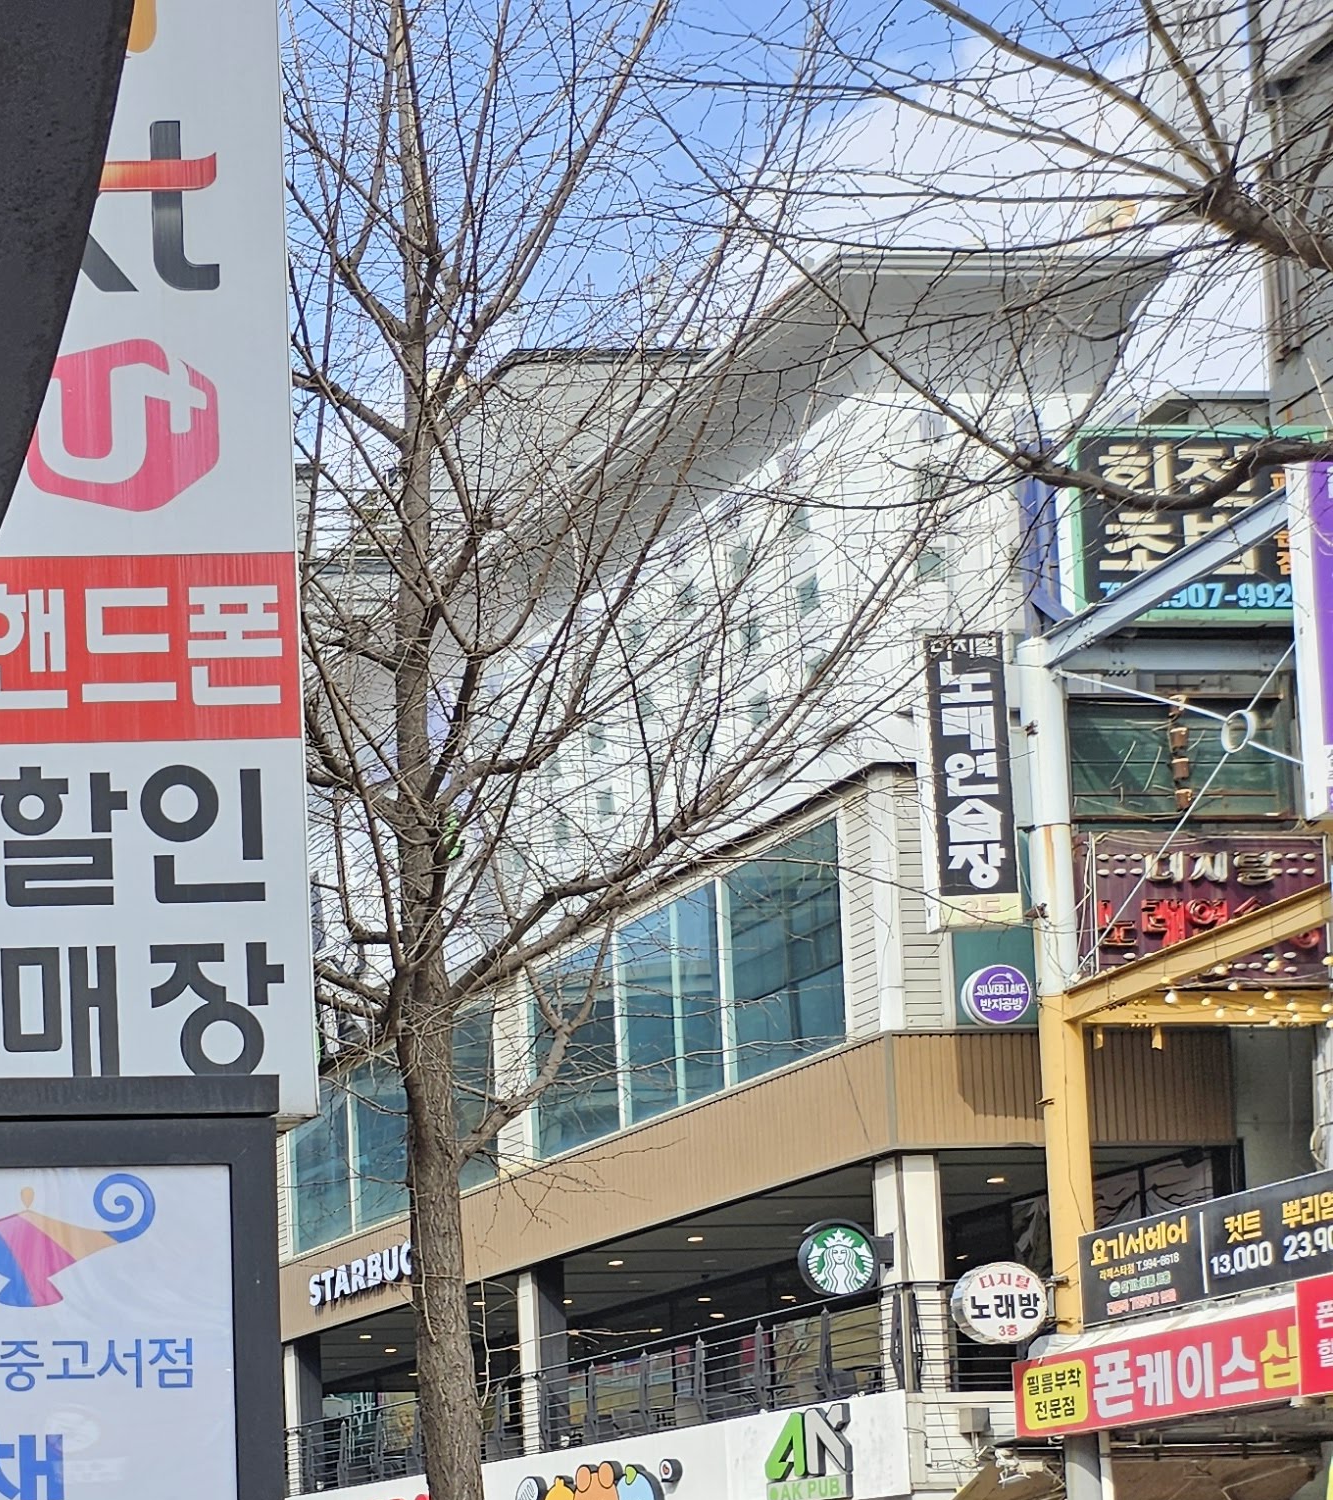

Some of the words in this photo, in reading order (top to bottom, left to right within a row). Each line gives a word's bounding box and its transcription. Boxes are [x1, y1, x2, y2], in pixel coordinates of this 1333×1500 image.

[938, 660, 1006, 890] 노래연습장
[1145, 850, 1276, 886] 디지털
[976, 983, 1005, 995] SILVER
[1005, 982, 1027, 994] LAKE
[0, 942, 285, 1077] 매장
[980, 997, 1023, 1012] 반지공방
[1224, 1210, 1263, 1243] 컷트
[1090, 1215, 1188, 1267] 요기서헤어
[979, 1272, 1031, 1290] 디지털
[970, 1292, 1040, 1320] 노래방
[998, 1324, 1019, 1337] 3층
[1026, 1367, 1081, 1396] 필름부착
[1035, 1395, 1076, 1422] 전문점
